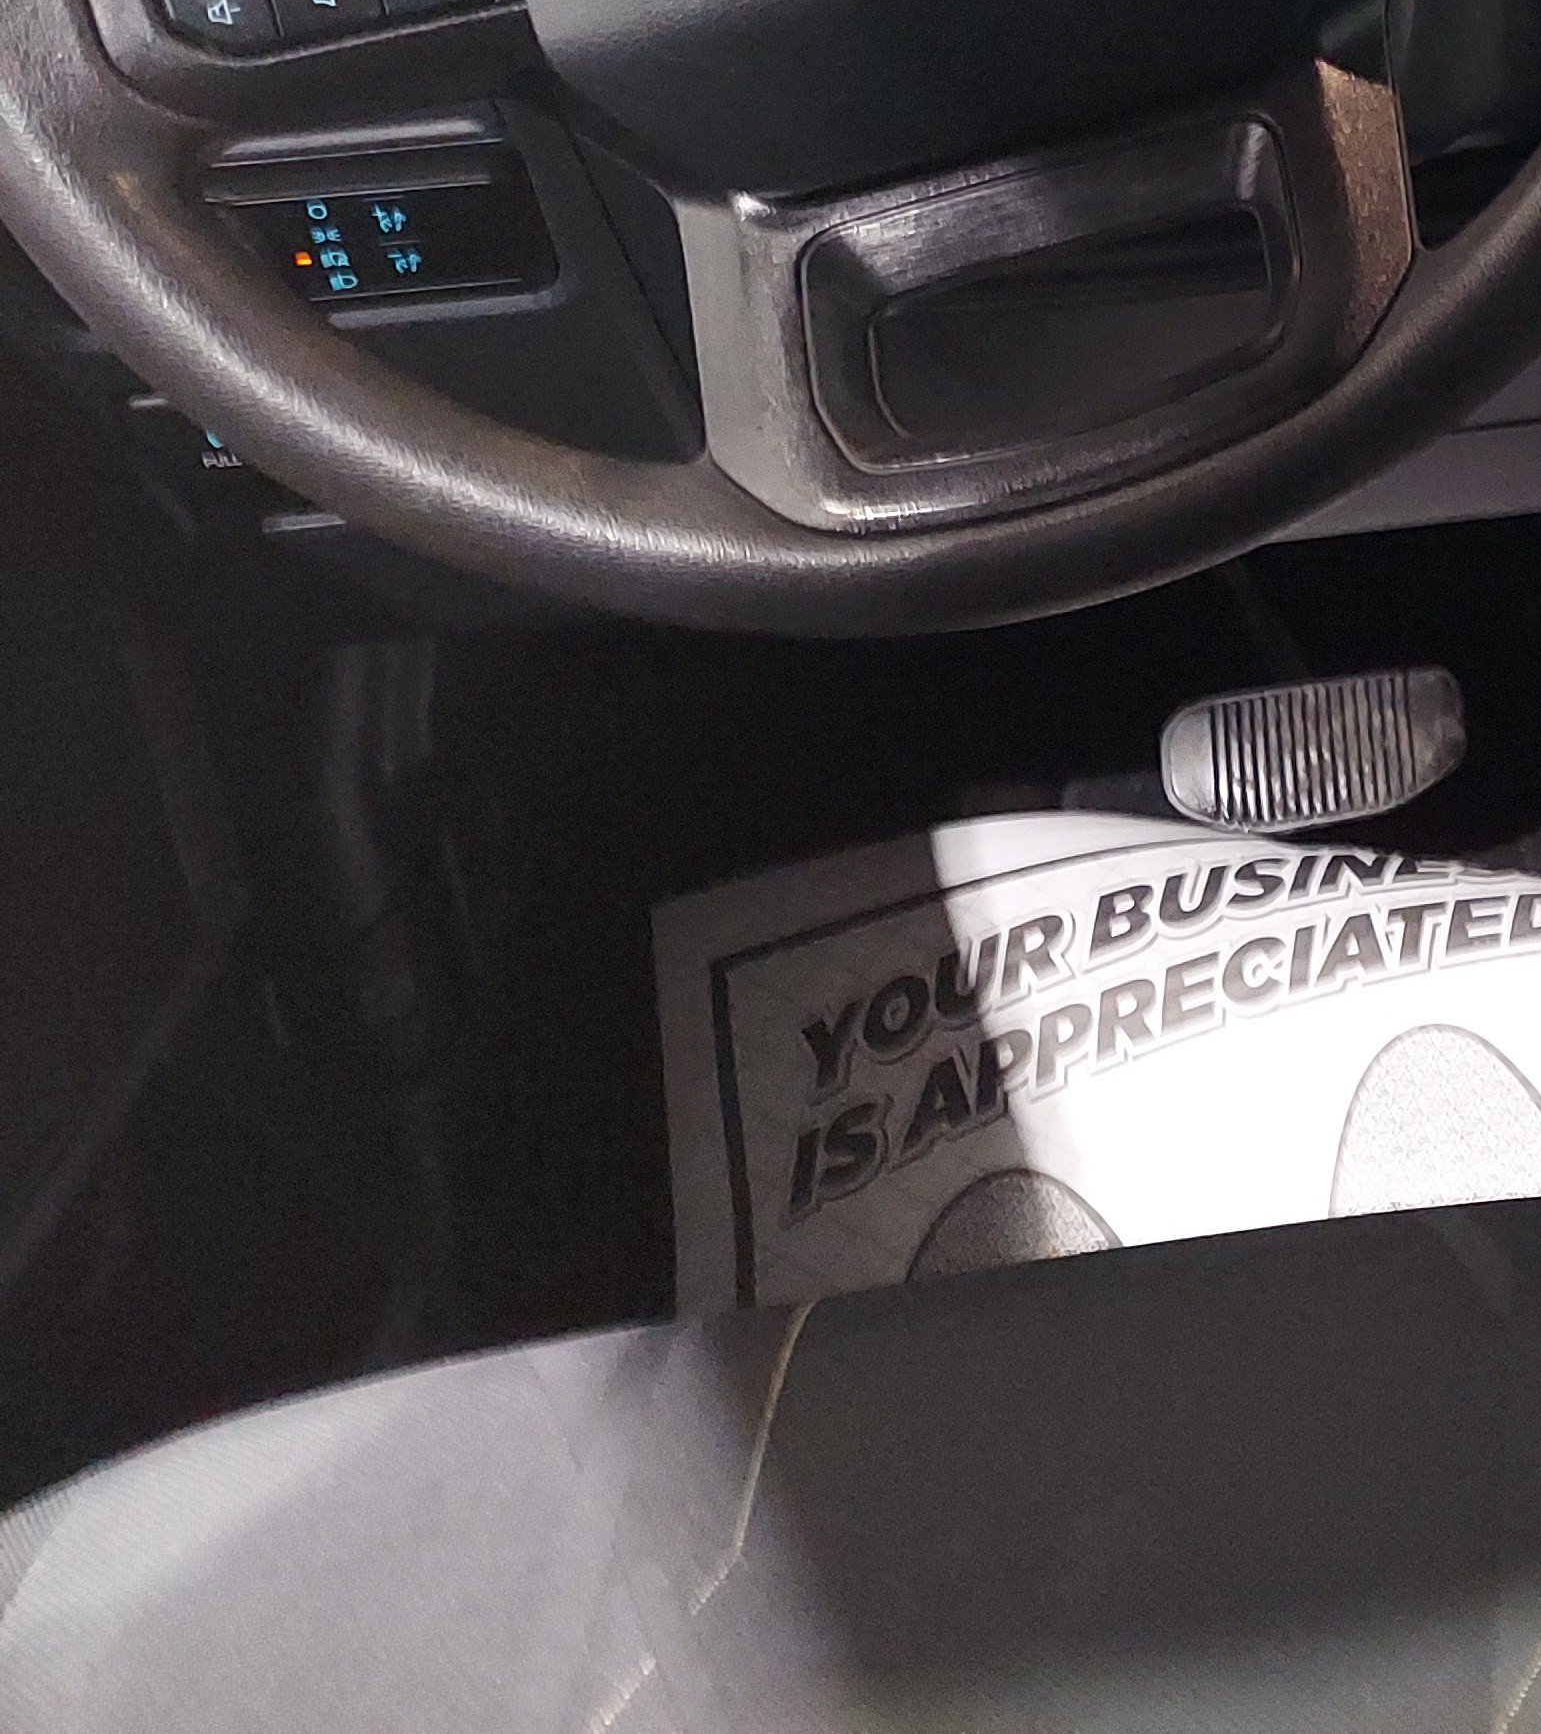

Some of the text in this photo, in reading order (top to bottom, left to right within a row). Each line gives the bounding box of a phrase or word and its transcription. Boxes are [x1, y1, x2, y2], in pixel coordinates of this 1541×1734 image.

[800, 848, 1480, 1101] YOUR BUSIN
[786, 1095, 893, 1219] IS
